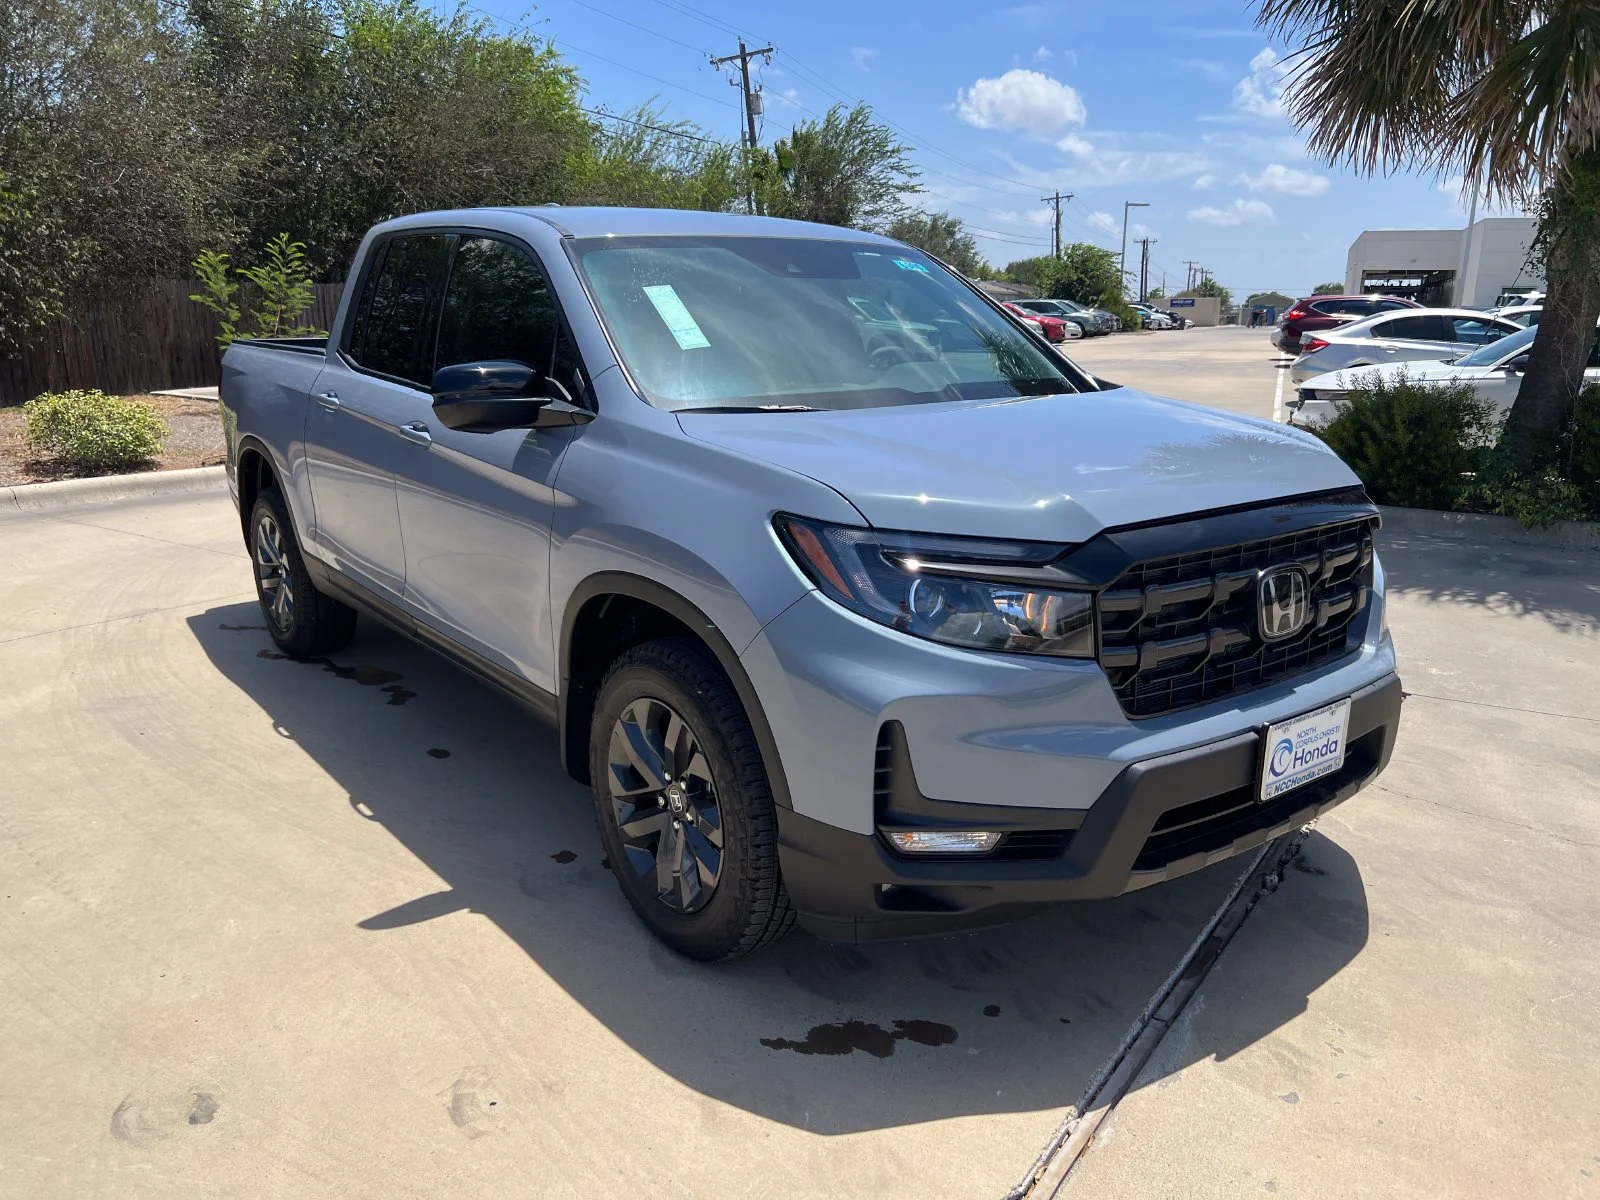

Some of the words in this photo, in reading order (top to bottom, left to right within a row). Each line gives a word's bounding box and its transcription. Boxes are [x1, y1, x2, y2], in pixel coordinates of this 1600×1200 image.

[1295, 734, 1319, 749] CORPUS
[1319, 726, 1340, 740] CHRISTI
[1297, 726, 1317, 740] NORTH
[1293, 738, 1338, 769] Honda
[1274, 764, 1333, 794] NCCHonda.com
